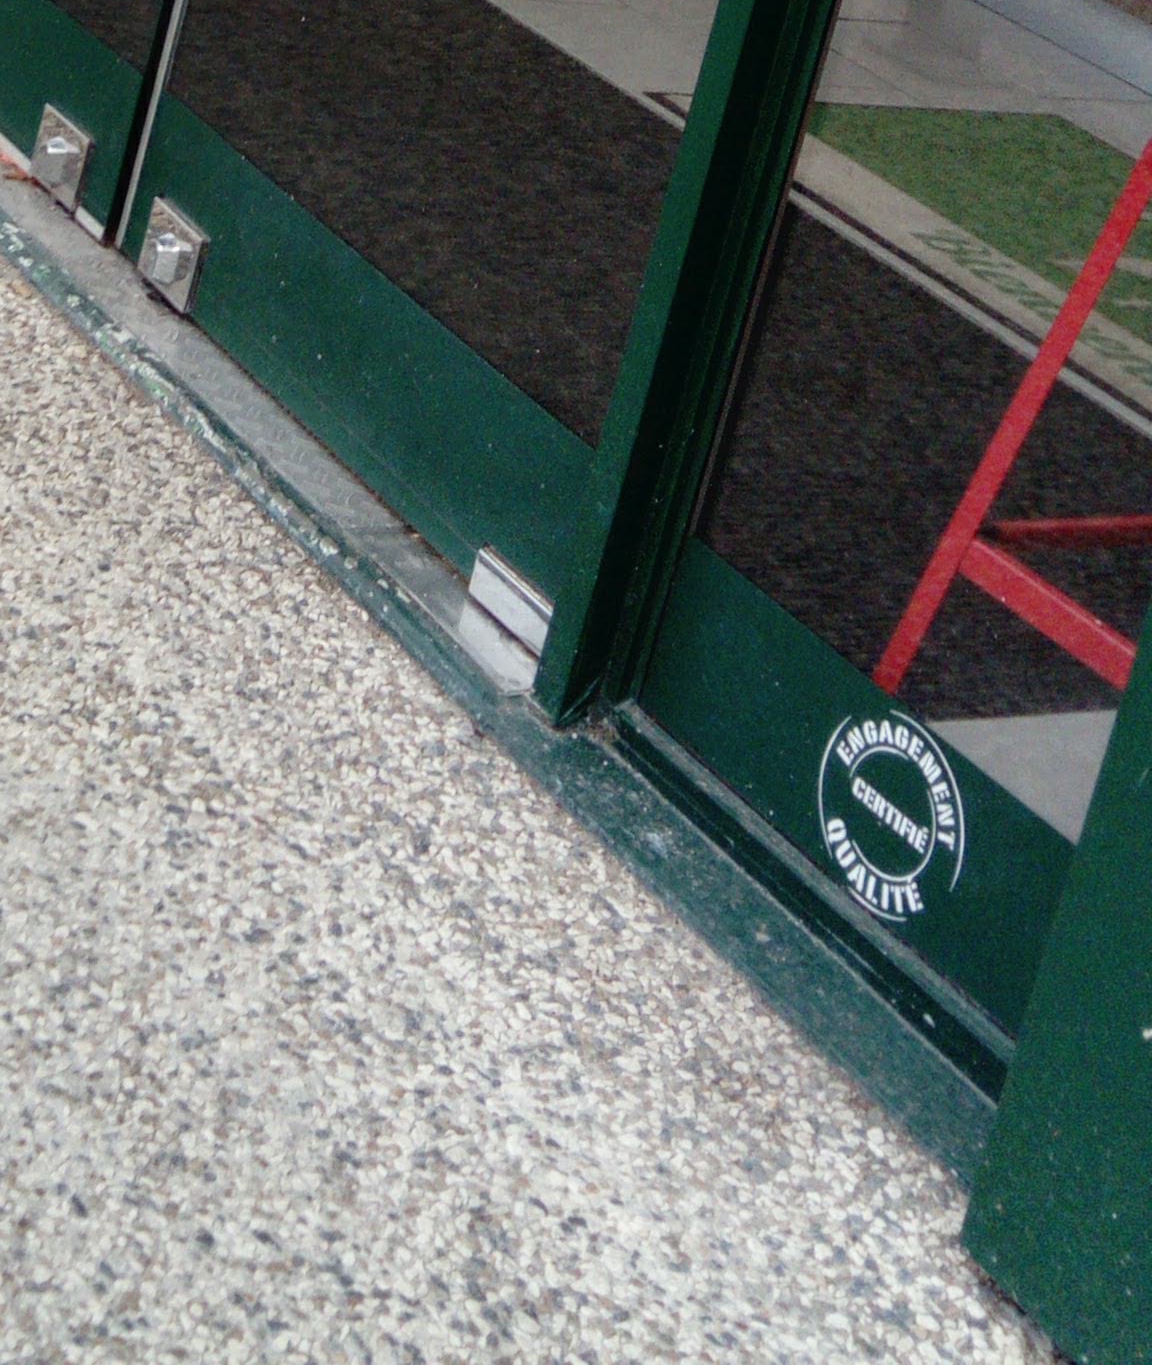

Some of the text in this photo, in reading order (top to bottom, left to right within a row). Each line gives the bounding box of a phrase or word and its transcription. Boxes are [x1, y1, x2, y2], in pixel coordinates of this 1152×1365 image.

[836, 720, 956, 851] ENGAGEMENT
[851, 776, 929, 854] CERTIFIÉ
[827, 818, 924, 913] QUALITÉ
